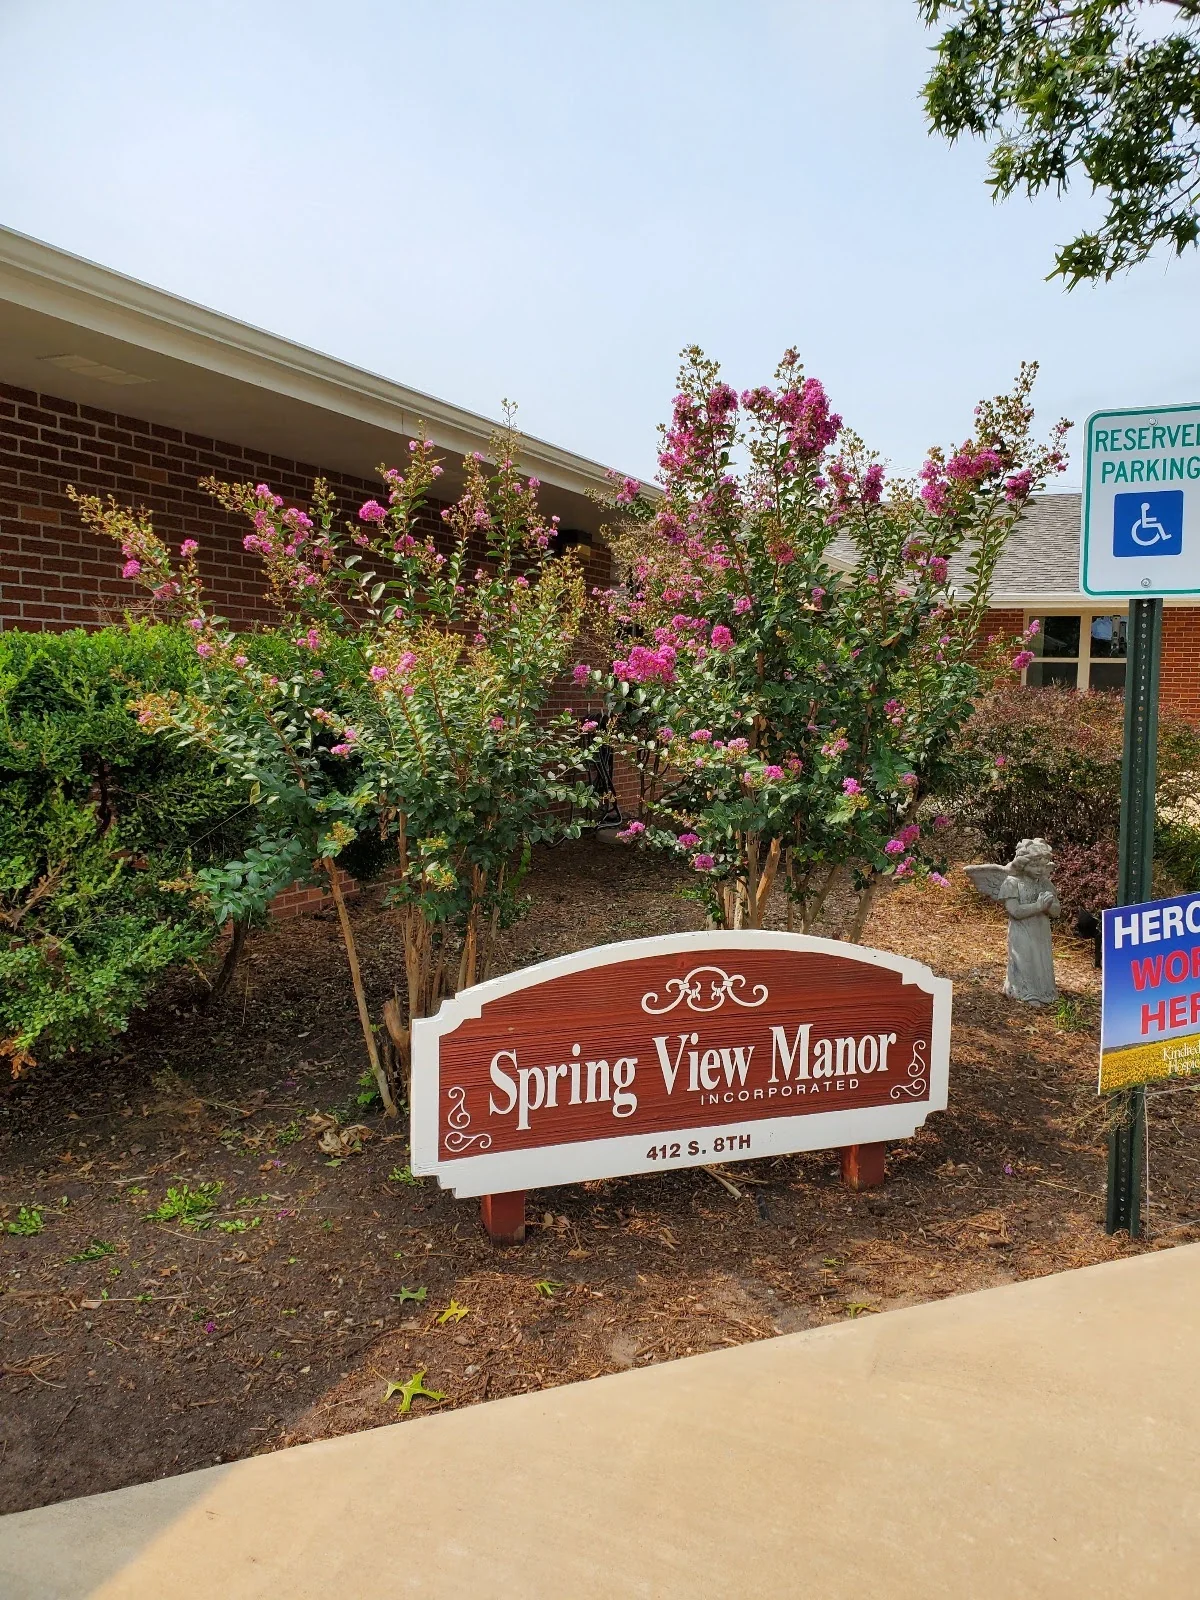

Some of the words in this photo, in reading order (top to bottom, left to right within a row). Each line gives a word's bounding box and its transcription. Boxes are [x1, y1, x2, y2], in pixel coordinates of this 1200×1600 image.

[1101, 456, 1200, 484] PARKING
[489, 1043, 638, 1131] Spring
[652, 1032, 755, 1095] View
[768, 1023, 897, 1083] Manor
[701, 1078, 860, 1106] INCORPORATED
[646, 1142, 681, 1161] 412
[687, 1140, 707, 1157] S.
[713, 1134, 751, 1153] 8TH
